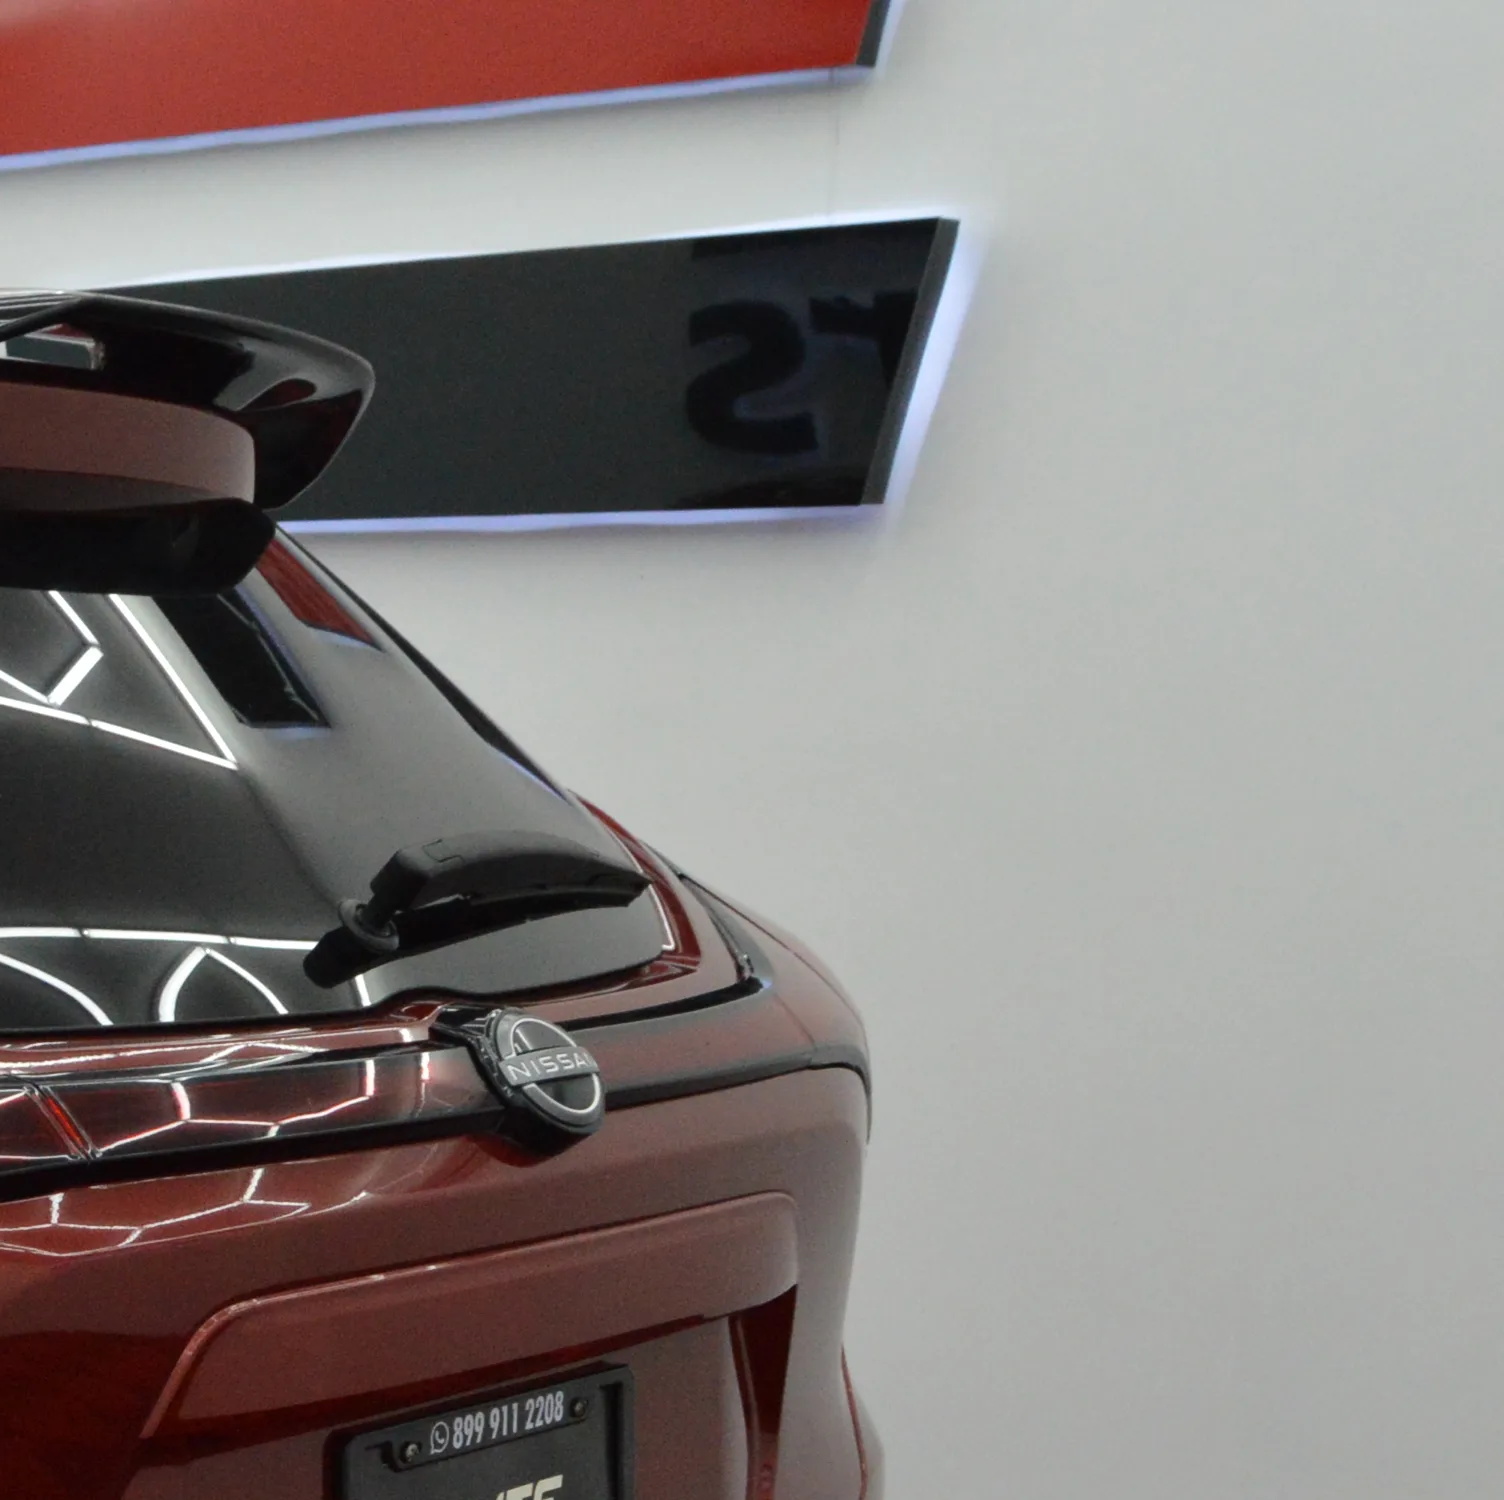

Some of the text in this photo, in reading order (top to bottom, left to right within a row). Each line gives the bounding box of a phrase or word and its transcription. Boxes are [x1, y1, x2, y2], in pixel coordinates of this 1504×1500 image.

[452, 1390, 564, 1449] 899 911 2208
